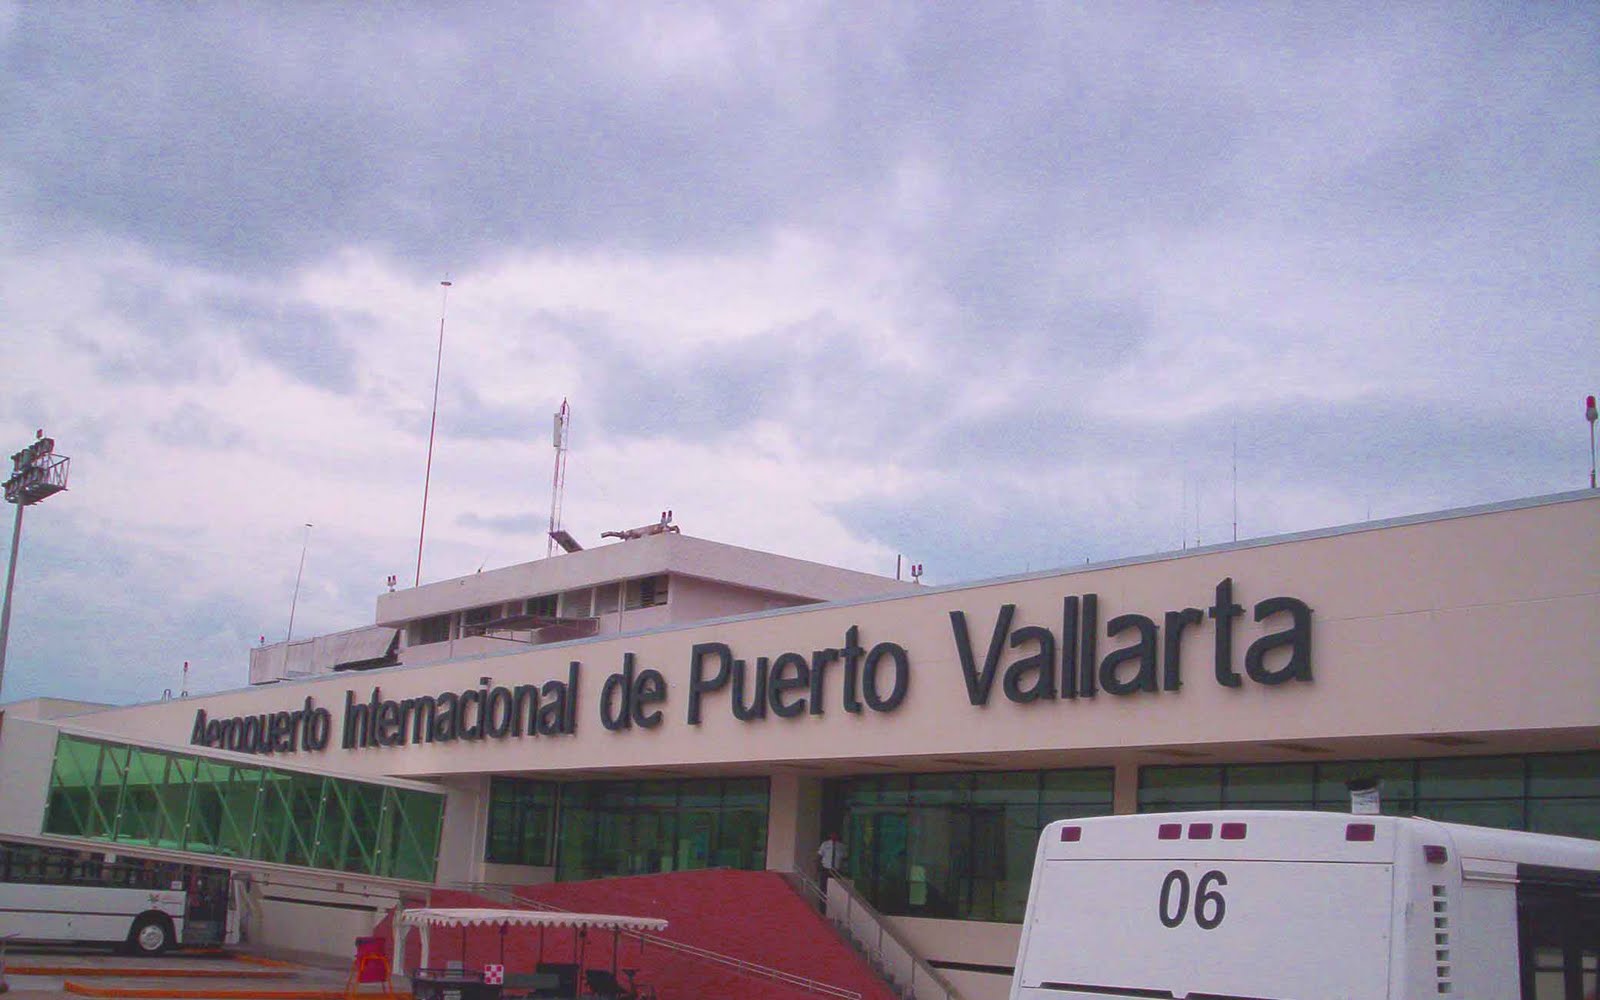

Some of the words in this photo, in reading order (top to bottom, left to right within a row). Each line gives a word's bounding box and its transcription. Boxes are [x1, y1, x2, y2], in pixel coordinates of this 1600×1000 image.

[191, 696, 331, 753] Aeropuerto
[342, 661, 579, 750] Internacional
[600, 652, 666, 731] de
[687, 624, 908, 725] Puerto
[949, 577, 1313, 705] Vallarta
[1159, 869, 1227, 930] 06
